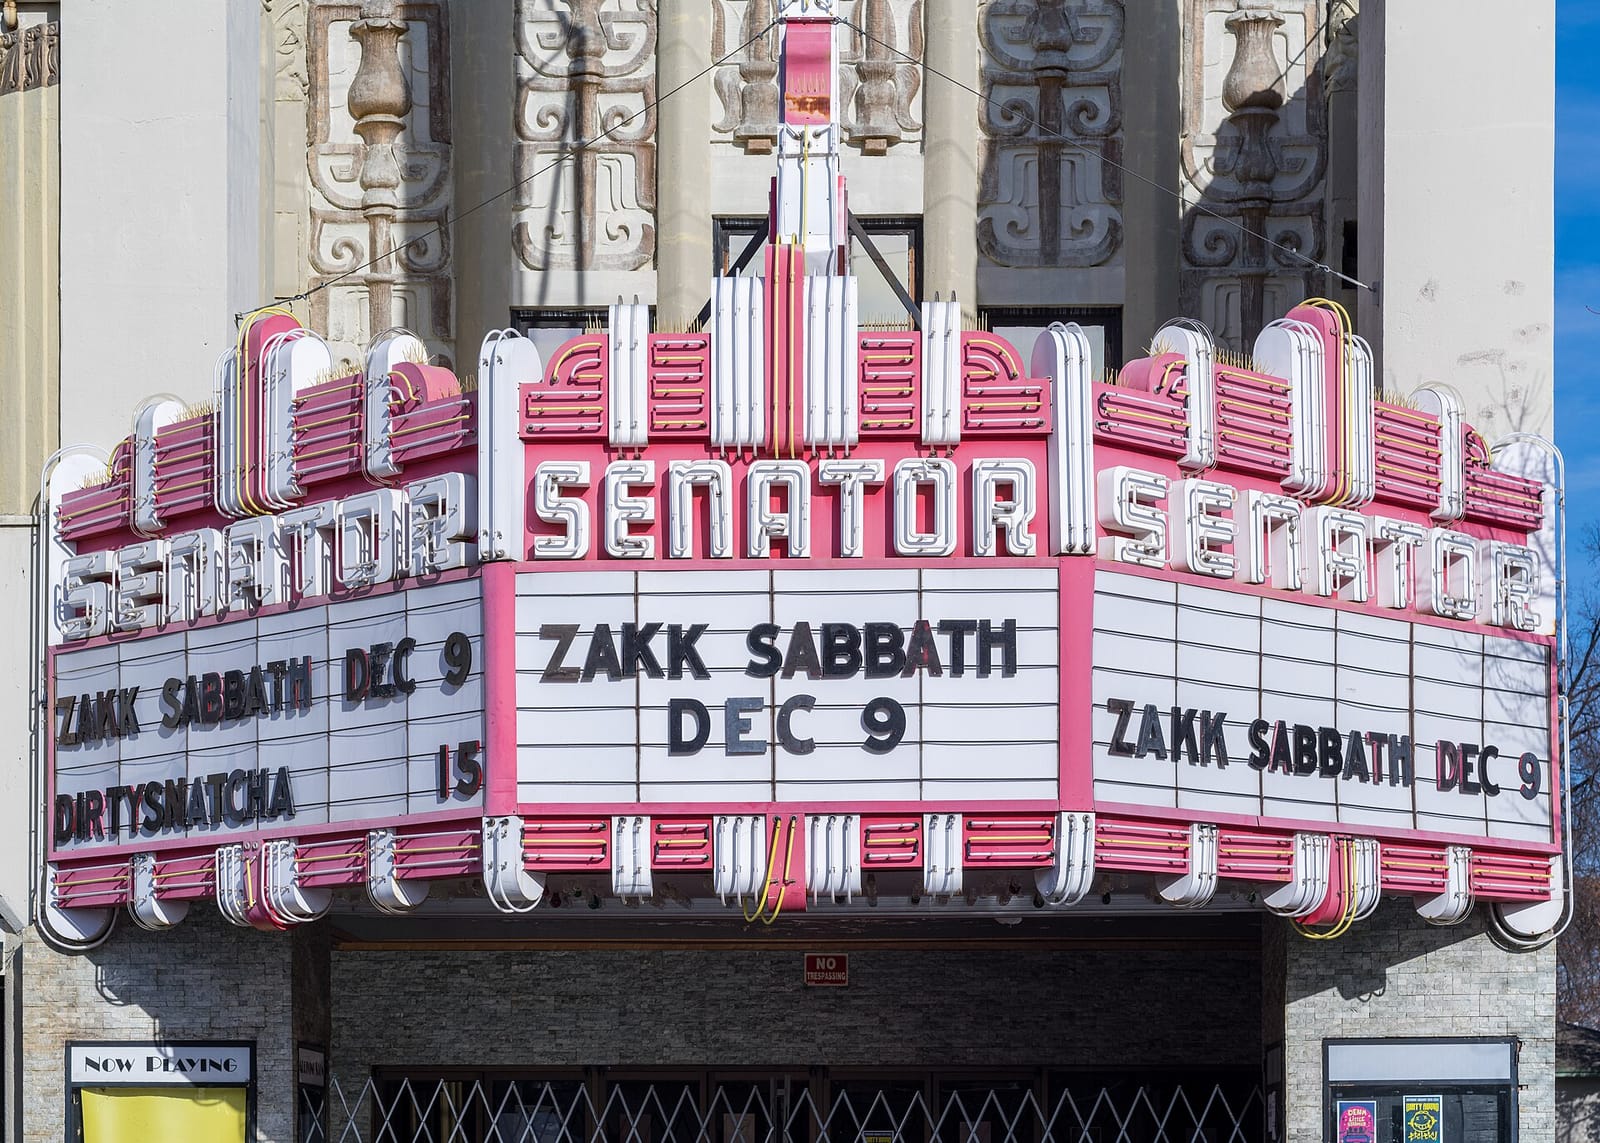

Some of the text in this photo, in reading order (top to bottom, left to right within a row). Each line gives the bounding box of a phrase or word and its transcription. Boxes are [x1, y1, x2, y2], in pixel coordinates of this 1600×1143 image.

[56, 471, 478, 641] SENATOR
[534, 458, 1037, 559] SENATOR
[1097, 465, 1542, 632] SENATOR
[56, 631, 472, 745] ZAKK SABBATH DEC 9
[539, 618, 1017, 683] ZAKK SABBATH
[667, 694, 906, 757] DEC 9
[1107, 698, 1541, 801] ZAKK SABBATH DEC 9
[56, 740, 483, 842] DIRTYSNATCHA 15
[807, 971, 846, 981] TRESPASSING
[816, 957, 837, 970] NO
